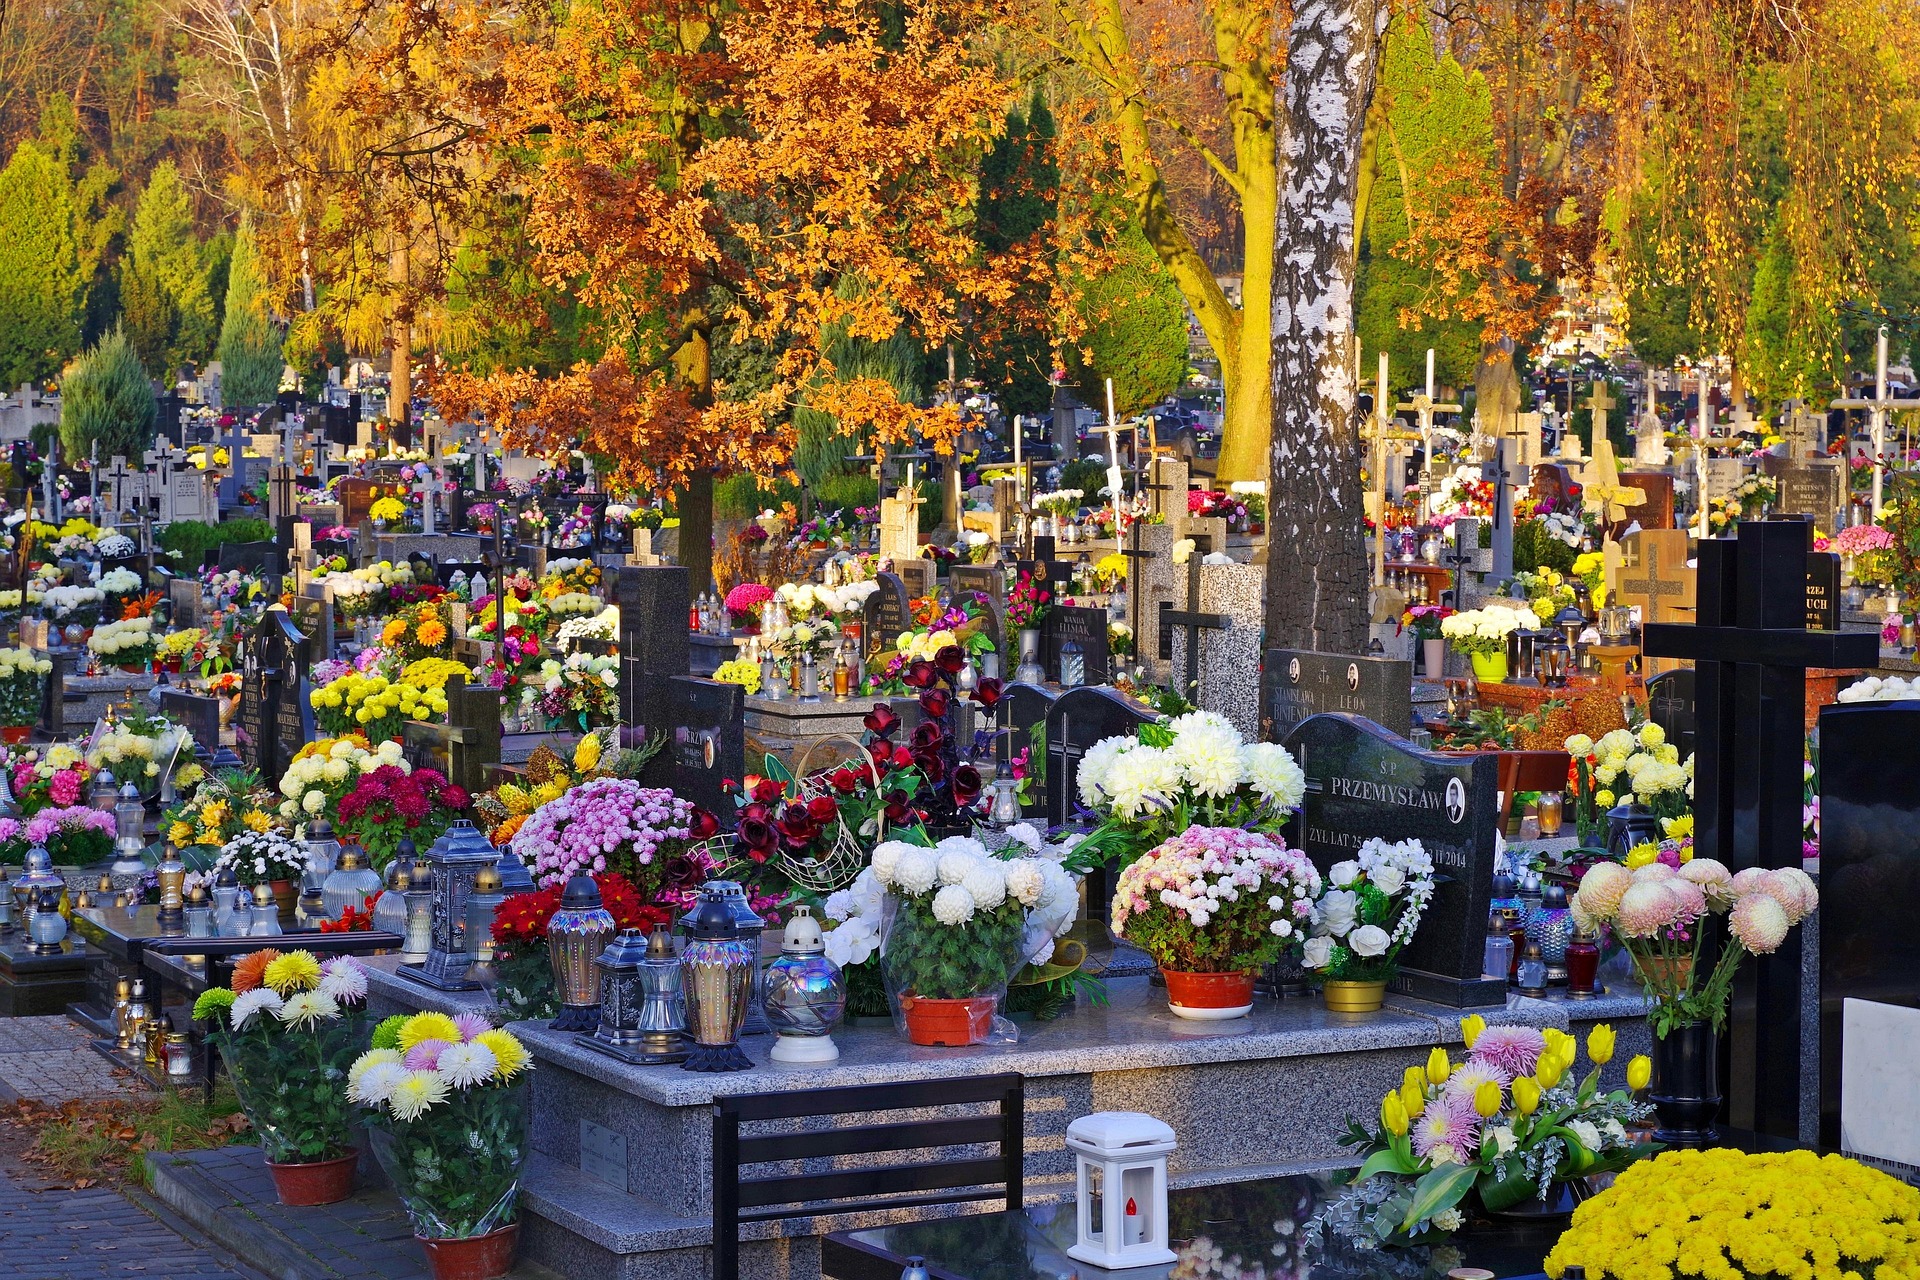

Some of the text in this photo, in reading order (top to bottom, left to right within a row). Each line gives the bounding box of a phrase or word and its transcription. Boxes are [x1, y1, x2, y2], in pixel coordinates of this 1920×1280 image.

[1806, 598, 1828, 610] UCH
[1340, 694, 1366, 711] LEON
[683, 729, 703, 746] JERZY
[1331, 776, 1444, 811] PRZEMYSŁAW
[1309, 824, 1329, 845] ŻYŁ
[1330, 830, 1350, 848] LAT
[1445, 851, 1467, 869] 2014
